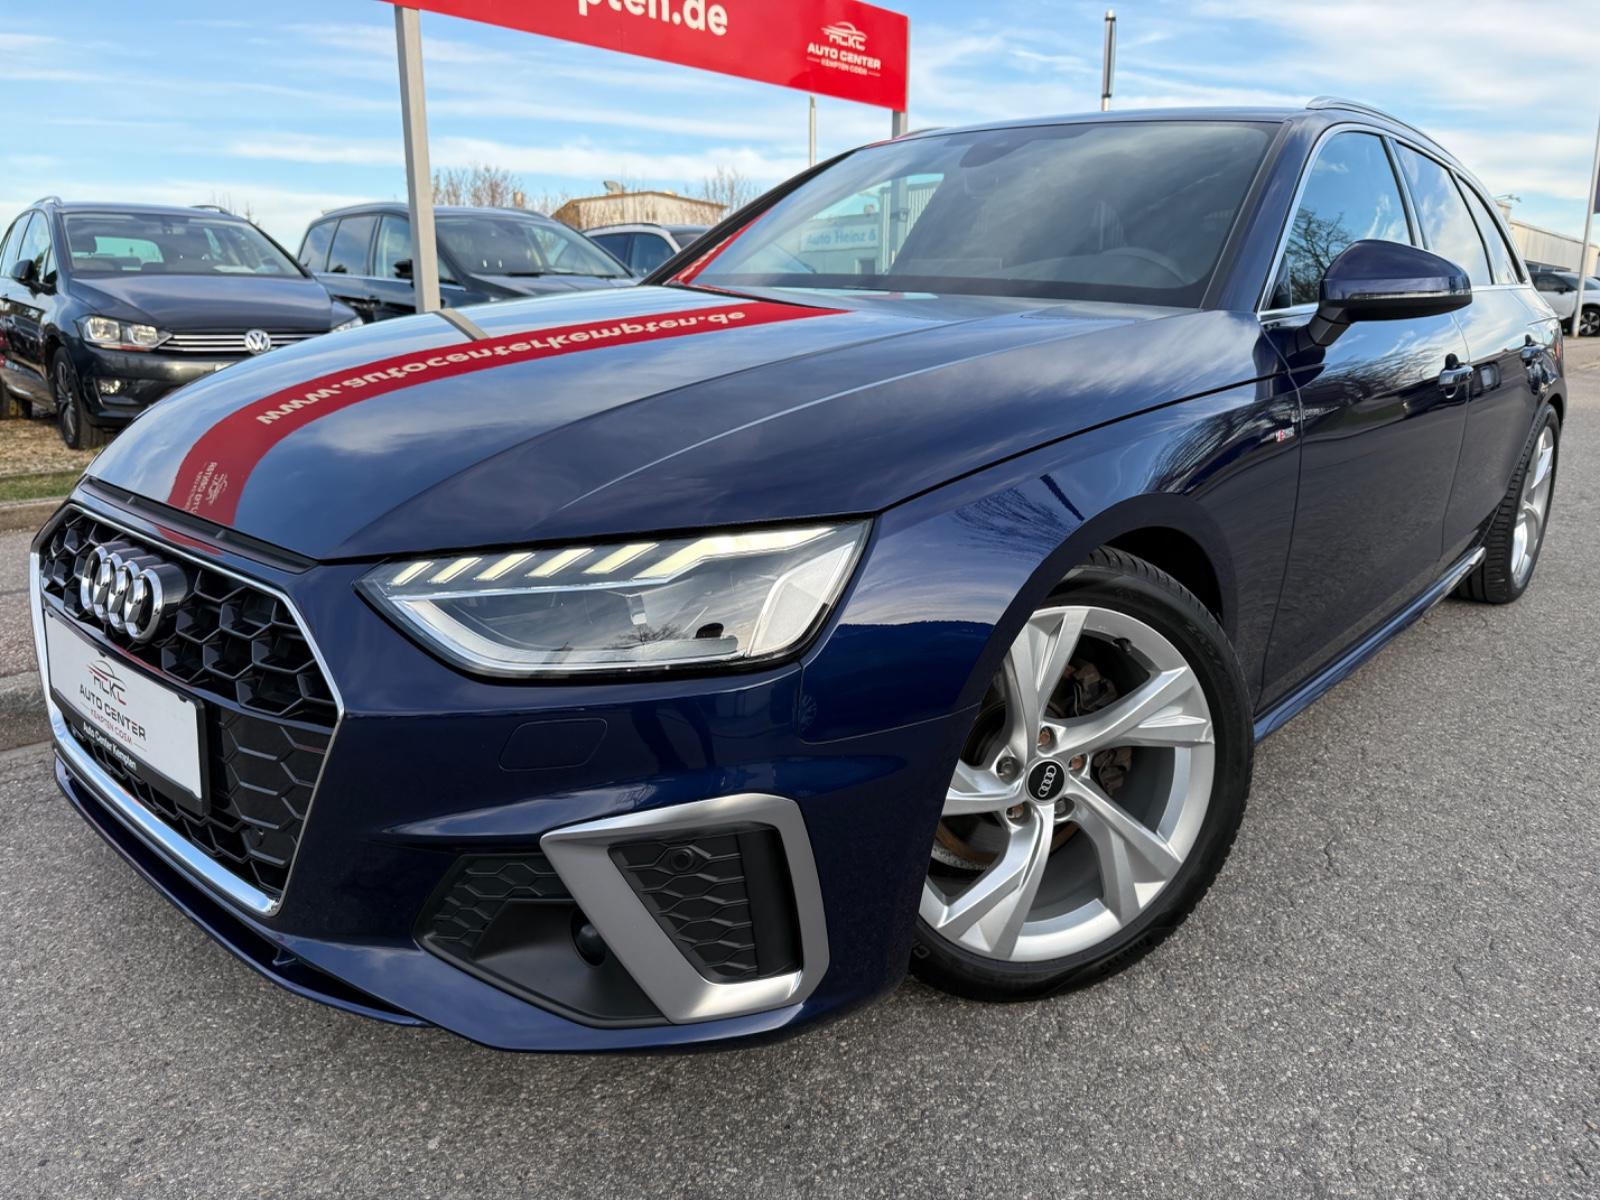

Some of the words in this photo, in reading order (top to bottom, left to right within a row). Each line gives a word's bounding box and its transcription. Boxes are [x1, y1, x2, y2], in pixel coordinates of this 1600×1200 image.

[807, 42, 838, 59] AUTO
[840, 50, 881, 70] CENTER
[836, 230, 866, 243] Heinz
[80, 683, 103, 710] AUTO
[104, 702, 147, 741] CENTER
